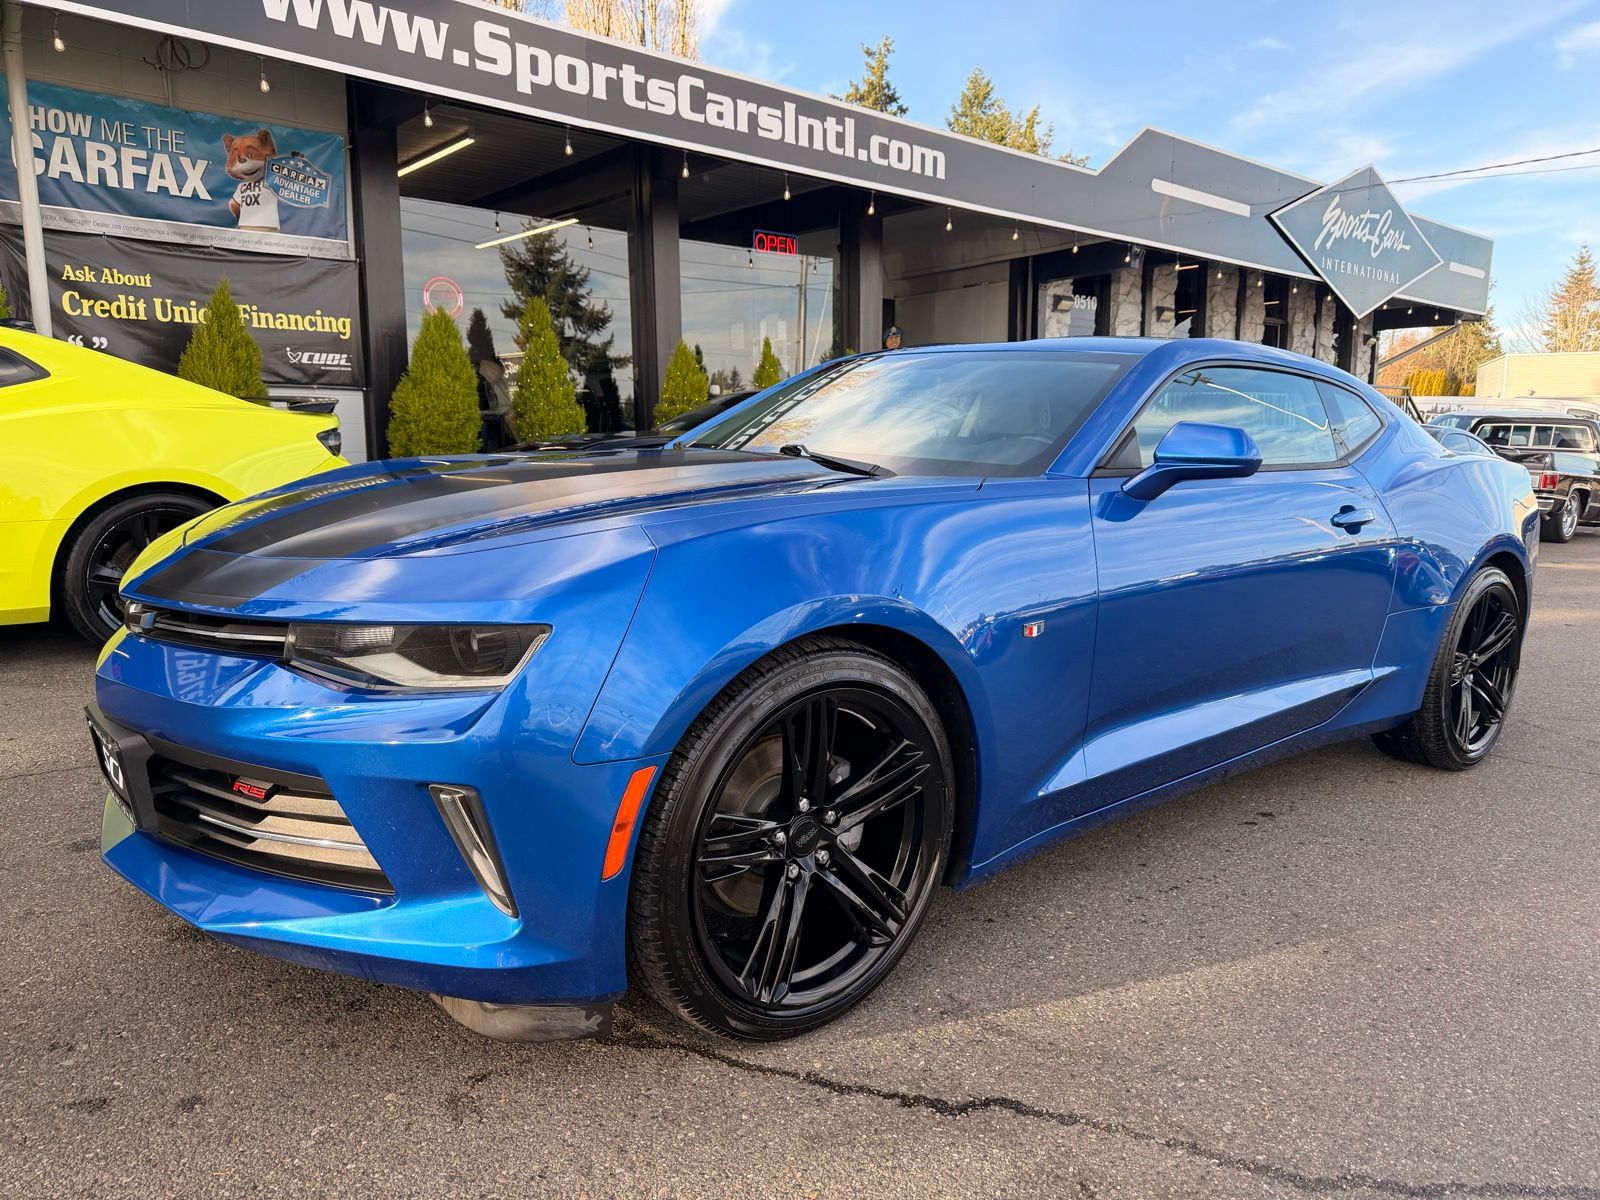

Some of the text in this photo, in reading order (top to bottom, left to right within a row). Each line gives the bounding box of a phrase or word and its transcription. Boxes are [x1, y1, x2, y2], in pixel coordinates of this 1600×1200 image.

[8, 104, 186, 154] HOW ME THE
[240, 181, 262, 194] CAR
[271, 163, 326, 191] CARFAX
[273, 176, 321, 199] ADVANTAGE
[240, 194, 261, 208] FOX
[279, 187, 311, 205] DEALER
[1314, 194, 1411, 258] Sports Cars
[755, 233, 796, 257] OPEN
[61, 264, 153, 288] Ask About
[1321, 256, 1401, 285] INTERNATIONAL
[61, 290, 352, 340] Credit Uni Financing
[301, 352, 352, 366] CUDL
[233, 781, 267, 799] RS
